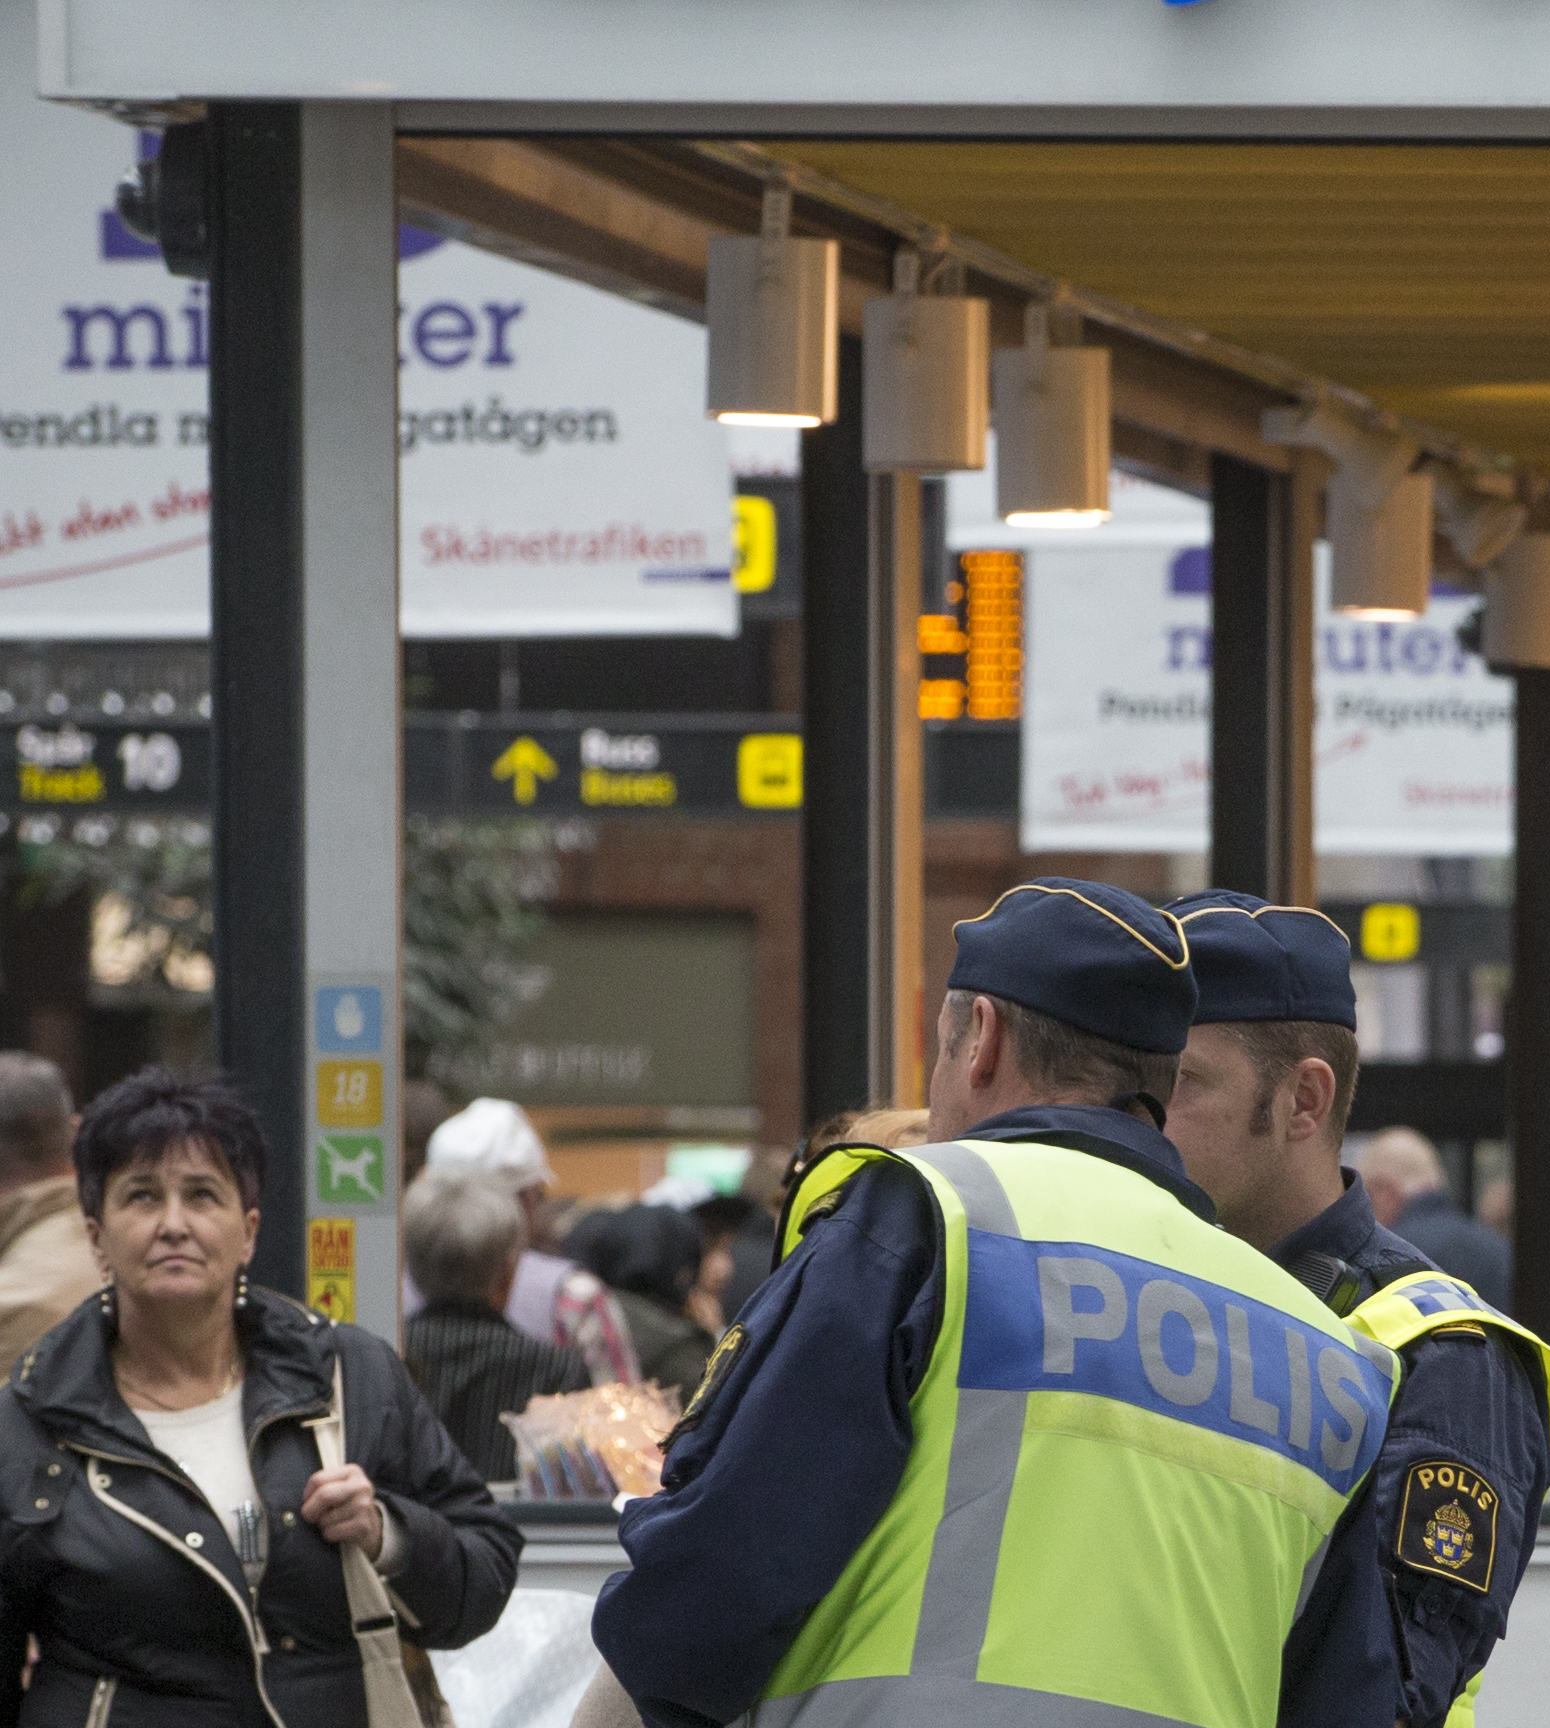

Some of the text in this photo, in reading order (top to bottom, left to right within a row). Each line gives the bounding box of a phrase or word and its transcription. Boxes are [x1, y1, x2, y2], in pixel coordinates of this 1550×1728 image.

[420, 524, 708, 566] Skånetrafiken
[120, 732, 182, 792] 10
[1036, 1256, 1367, 1472] POLIS
[1417, 1467, 1492, 1511] POLIS
